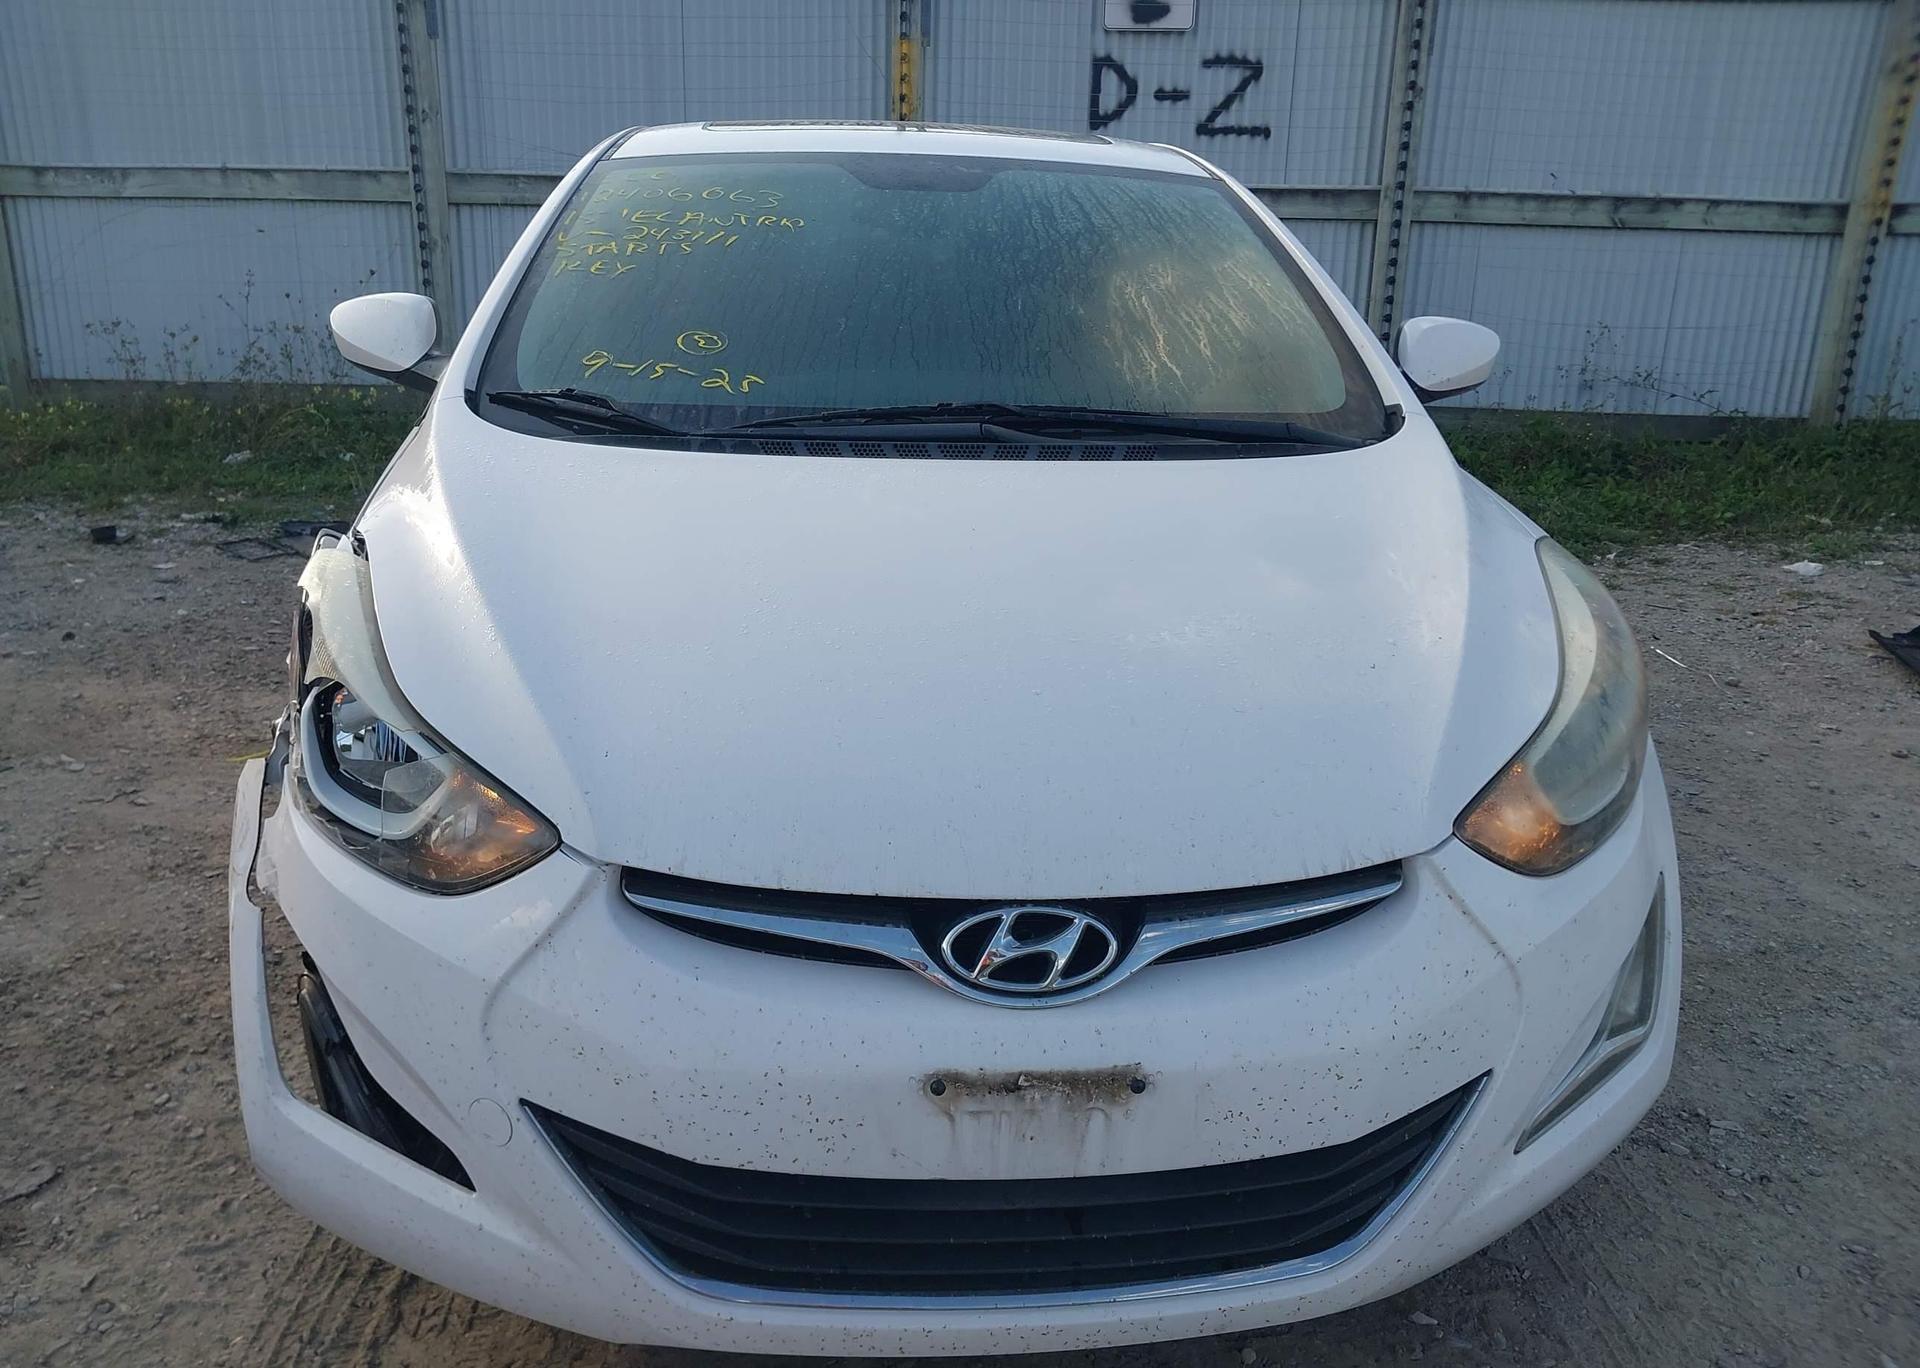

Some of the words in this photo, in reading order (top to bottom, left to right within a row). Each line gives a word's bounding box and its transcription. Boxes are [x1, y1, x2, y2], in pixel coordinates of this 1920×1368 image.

[1090, 53, 1271, 138] D-Z
[556, 240, 694, 257] STARTS
[555, 258, 637, 280] KEY
